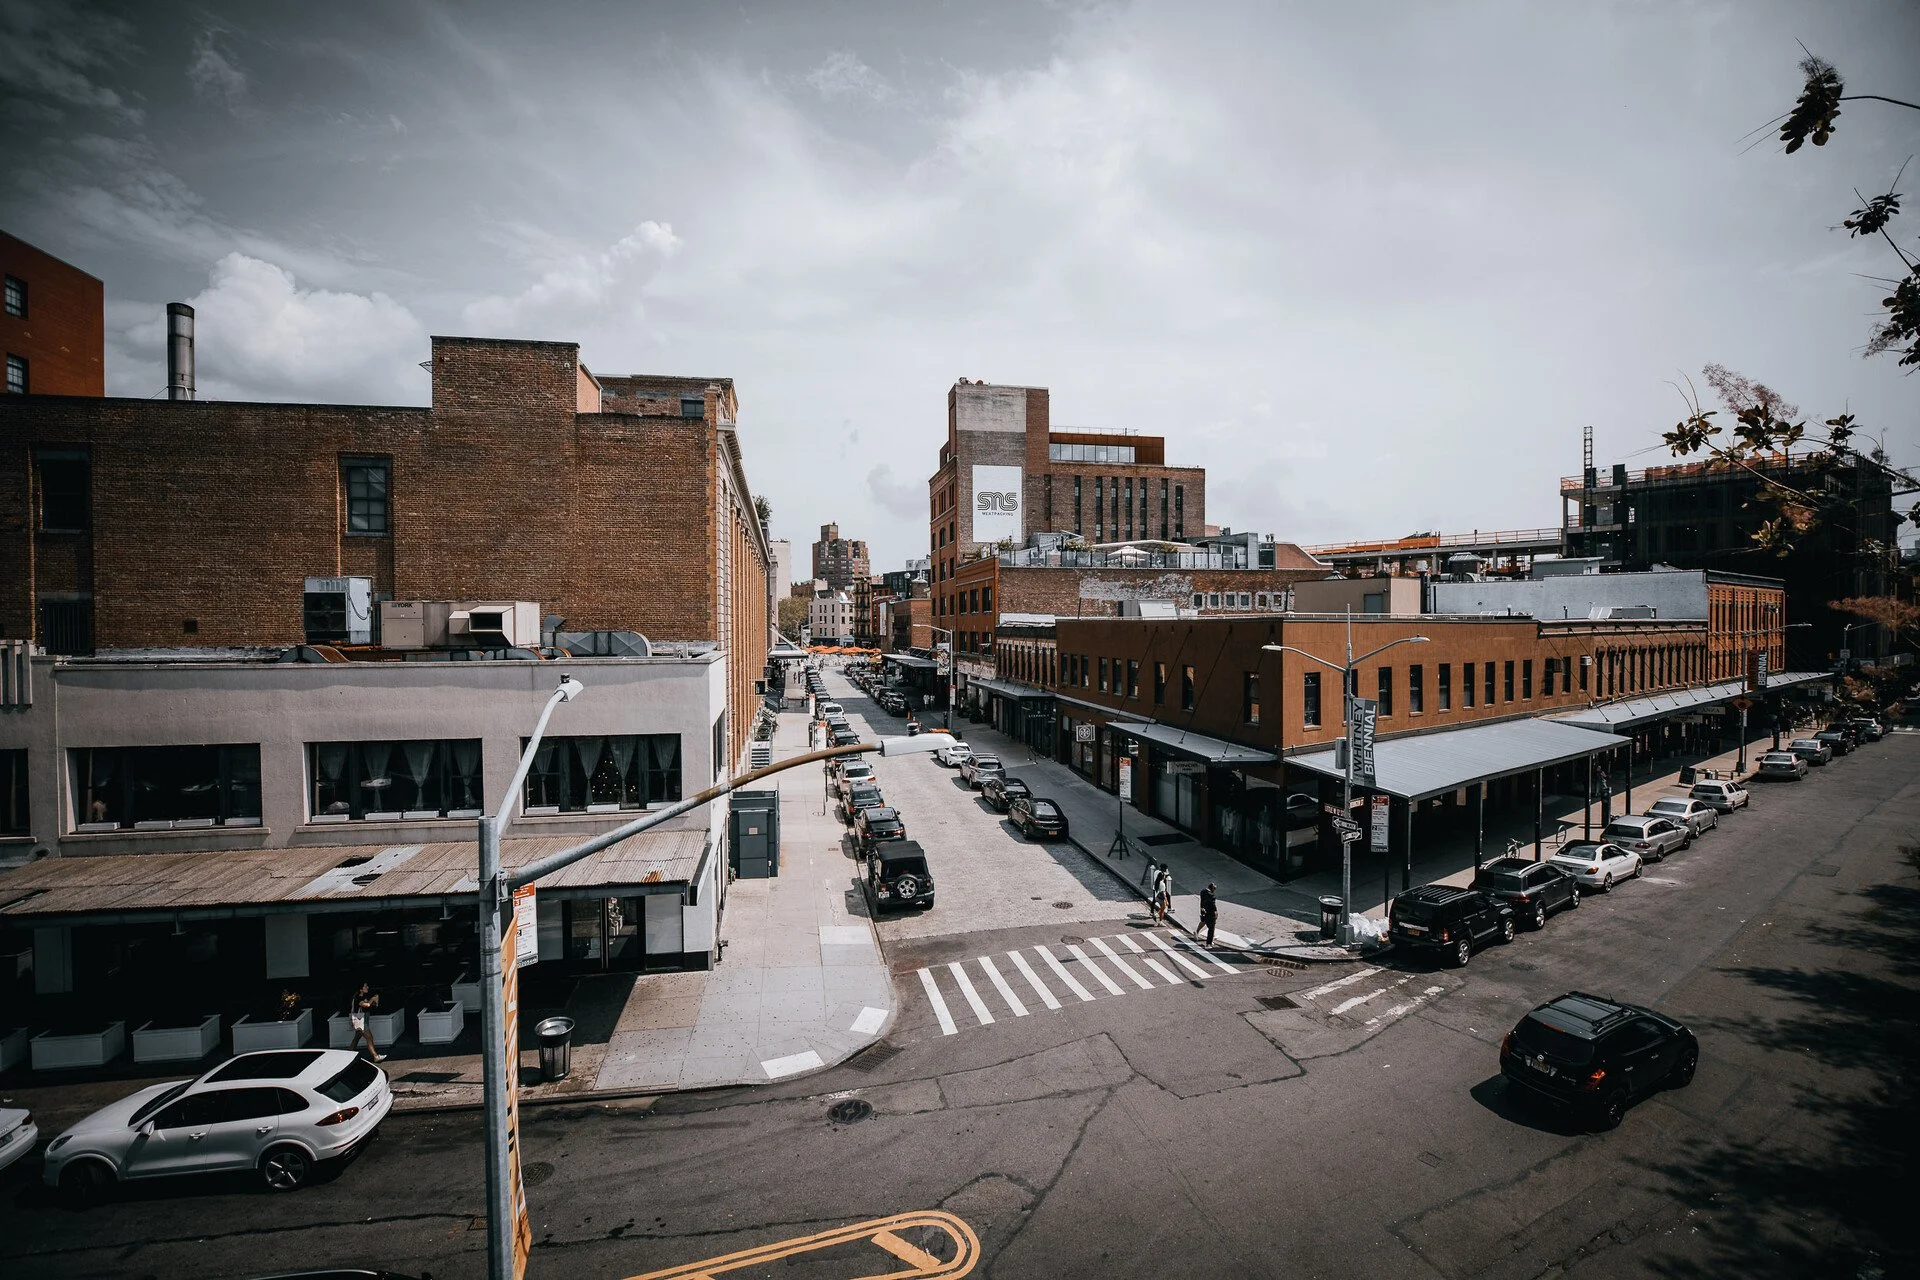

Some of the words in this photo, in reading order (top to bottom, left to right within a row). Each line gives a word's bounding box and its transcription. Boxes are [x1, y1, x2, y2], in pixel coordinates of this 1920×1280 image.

[1757, 652, 1767, 685] BIENNIAL
[1353, 703, 1363, 772] WHITNEY
[1363, 705, 1376, 775] BIENNIAL
